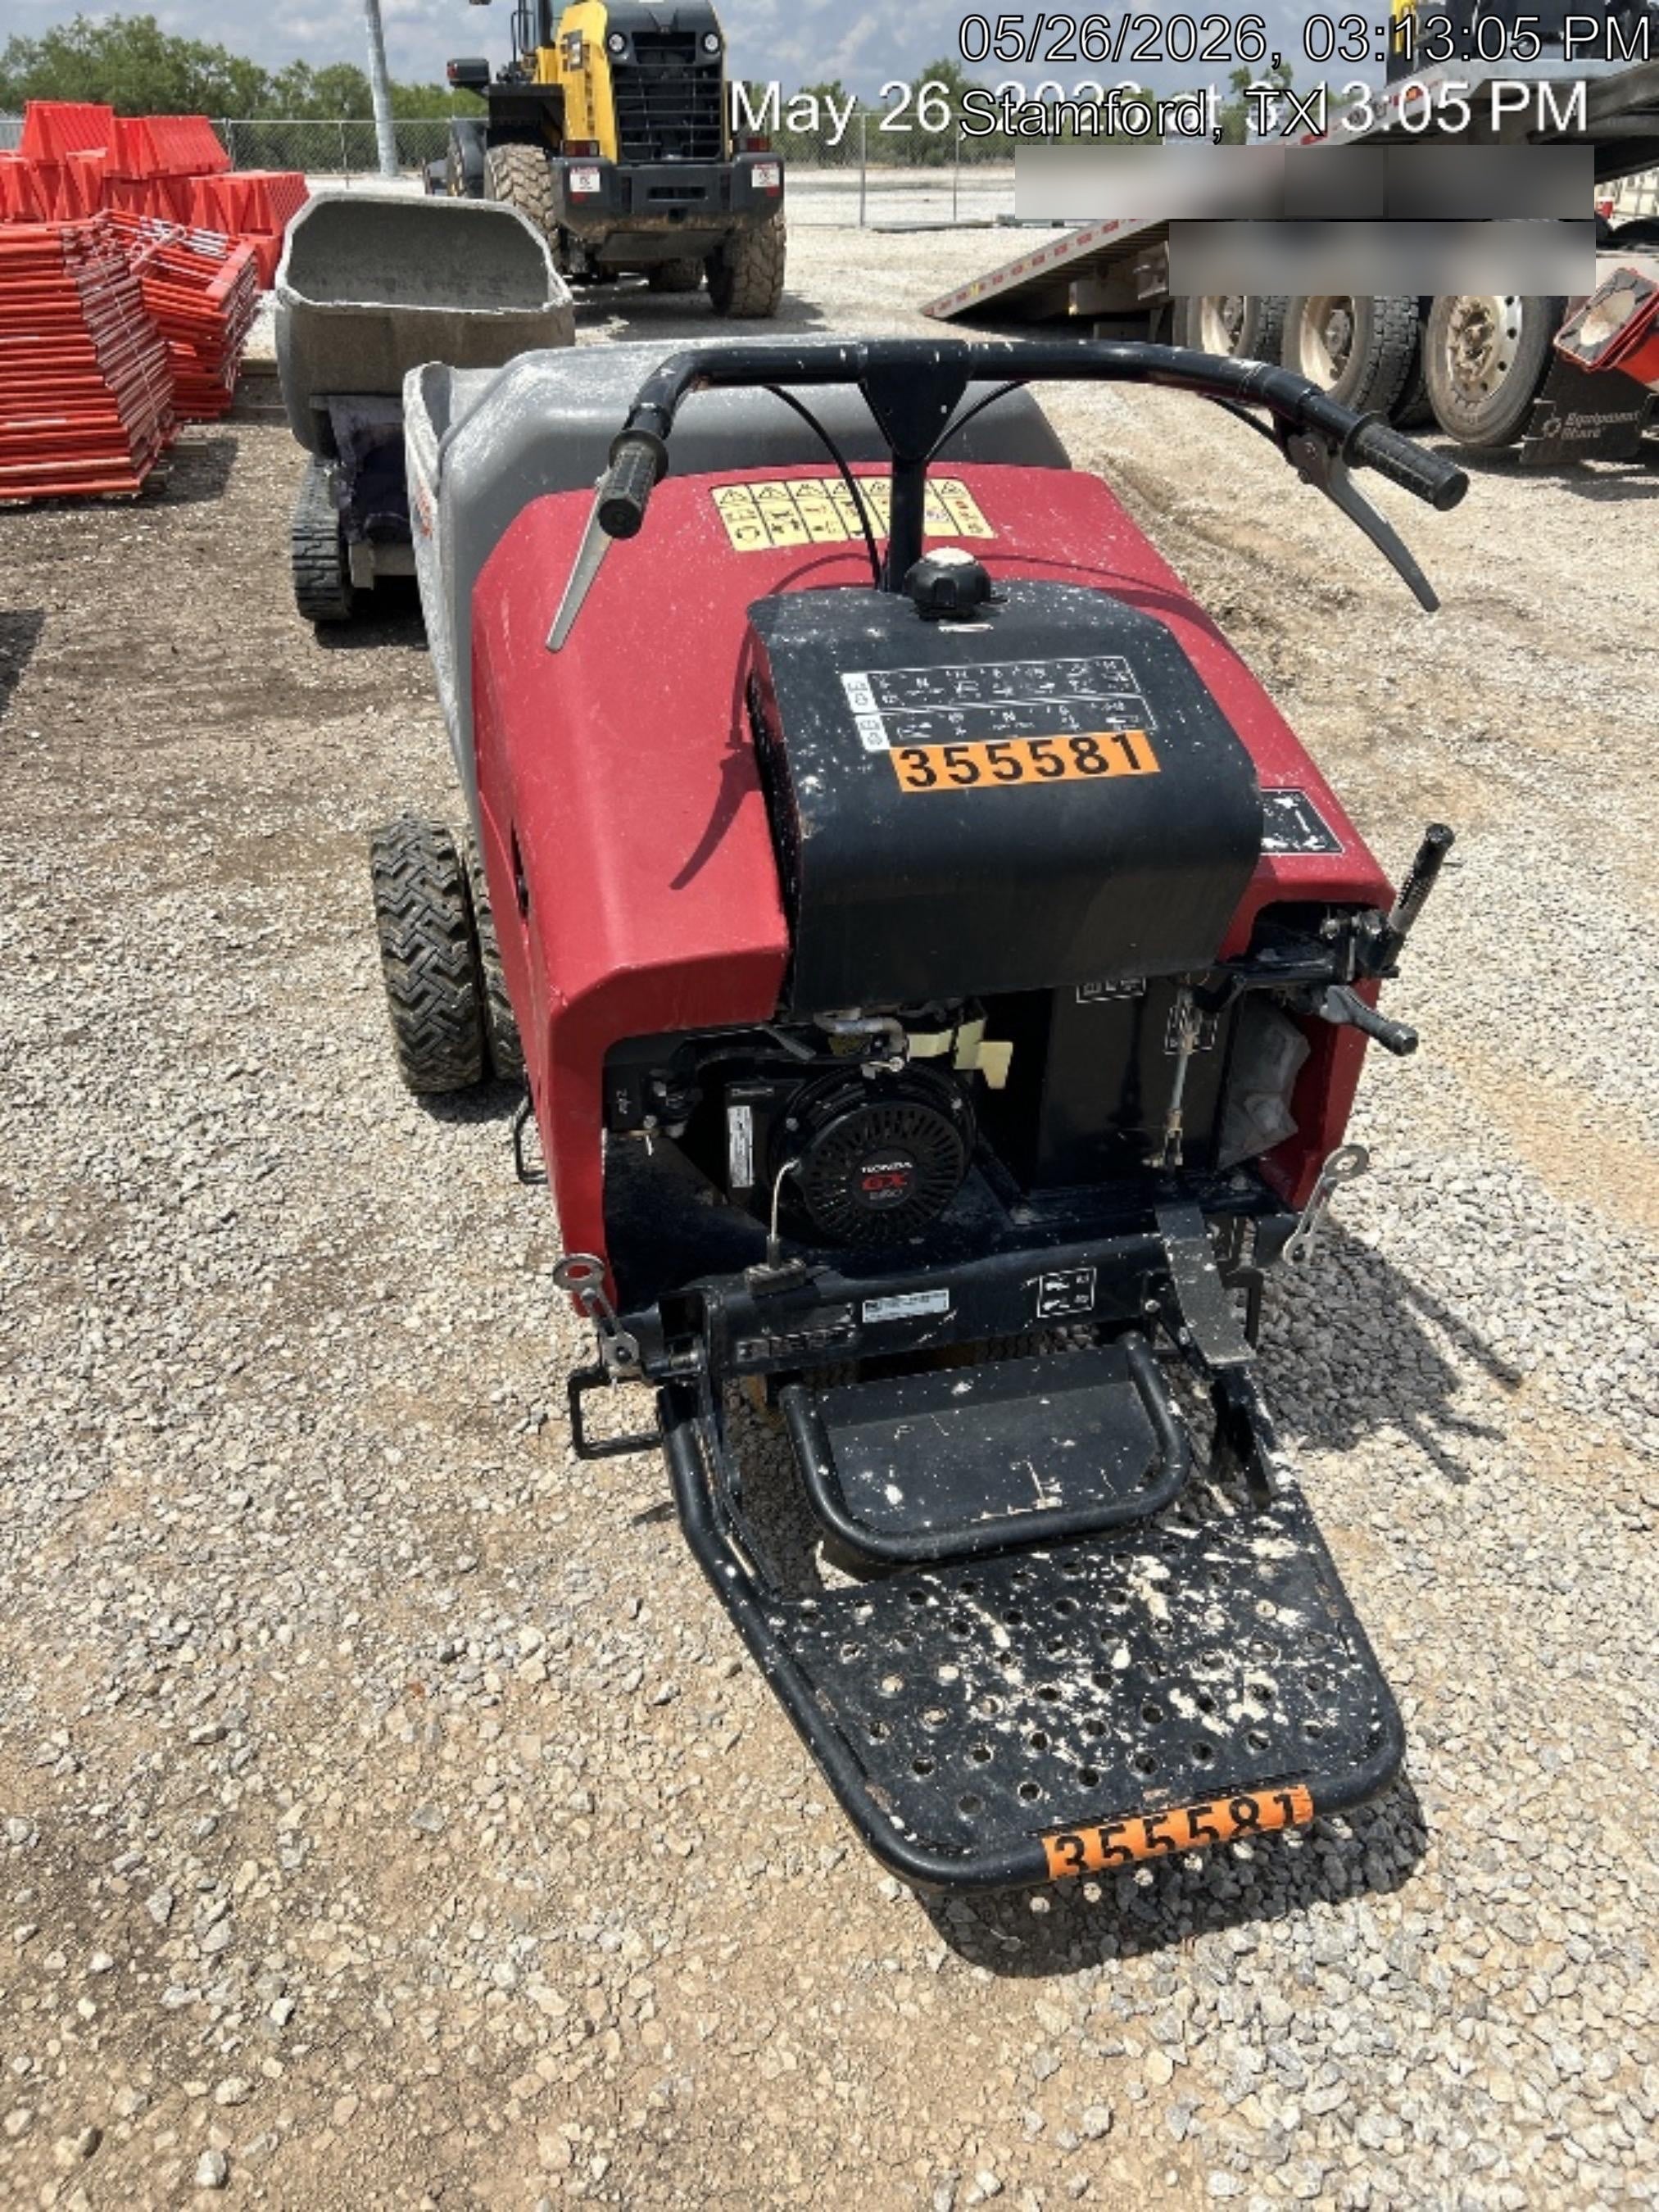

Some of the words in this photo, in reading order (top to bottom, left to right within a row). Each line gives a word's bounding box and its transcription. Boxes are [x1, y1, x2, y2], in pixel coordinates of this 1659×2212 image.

[899, 732, 1142, 788] 355581
[861, 1162, 913, 1174] HONDA
[1055, 1793, 1294, 1874] 355581
